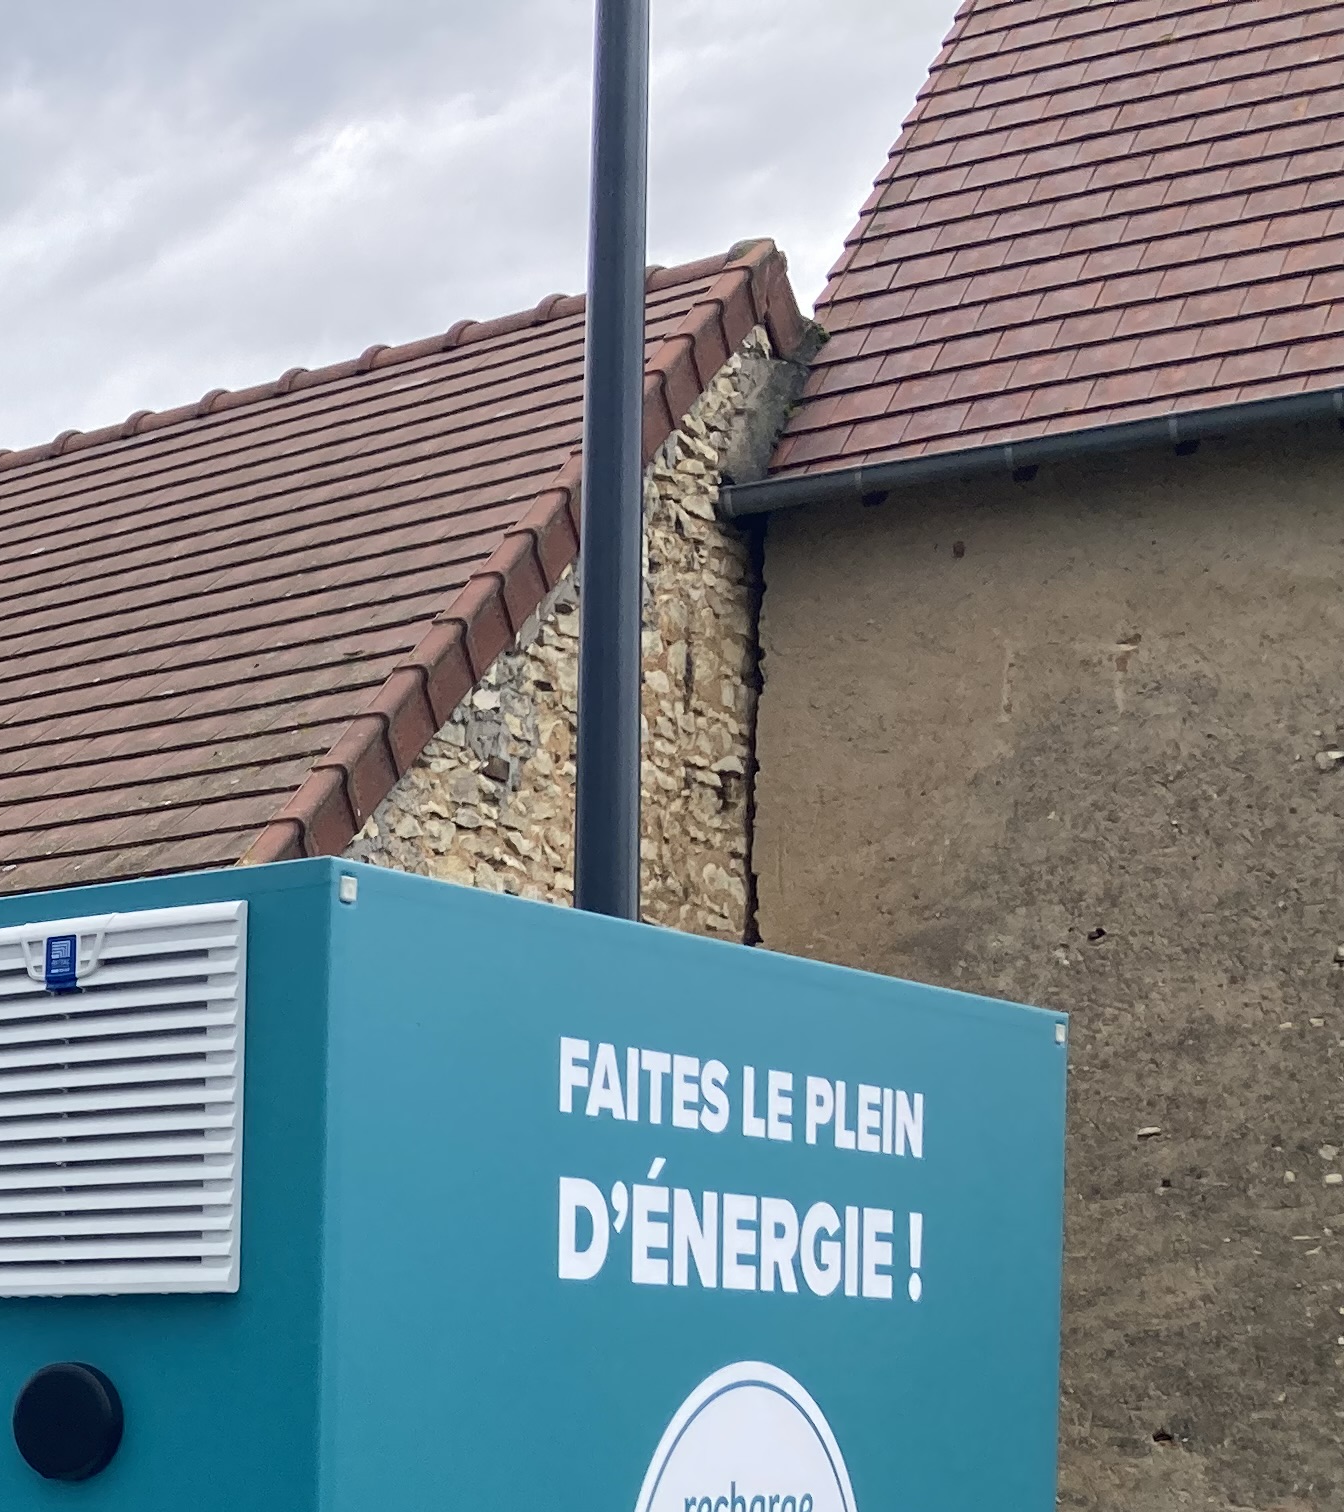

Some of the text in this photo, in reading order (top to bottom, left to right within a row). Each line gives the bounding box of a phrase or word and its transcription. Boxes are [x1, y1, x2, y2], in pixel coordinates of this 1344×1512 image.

[558, 1035, 925, 1159] FAITES LE PLEIN
[557, 1156, 894, 1300] D'ÉNERGIE
